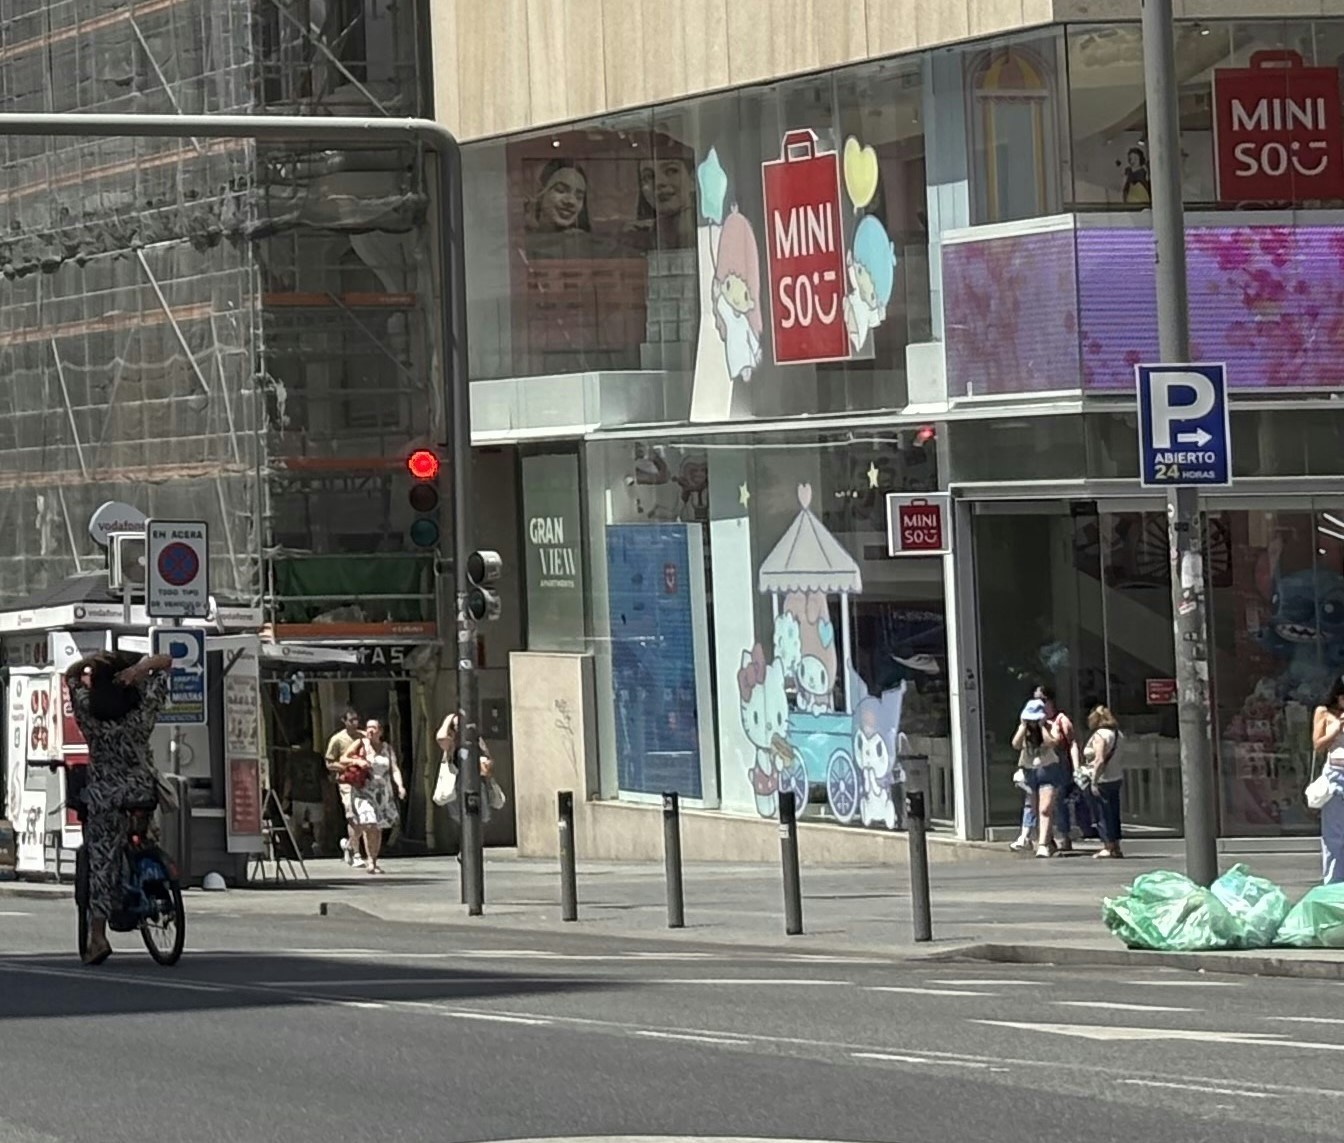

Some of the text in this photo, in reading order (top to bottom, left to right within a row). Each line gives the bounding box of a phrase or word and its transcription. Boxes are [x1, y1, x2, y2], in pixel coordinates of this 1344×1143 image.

[1231, 98, 1326, 132] MINI
[774, 201, 835, 260] MINI
[1149, 371, 1215, 449] P
[1154, 452, 1215, 464] ABIERTO
[1154, 464, 1215, 479] 24 HORAS
[903, 513, 937, 527] MINI
[153, 530, 203, 539] EN ACERA
[529, 517, 564, 544] GRAN
[539, 548, 577, 575] VIEW
[158, 588, 199, 596] TODO TIPO
[88, 609, 123, 618] vodafone
